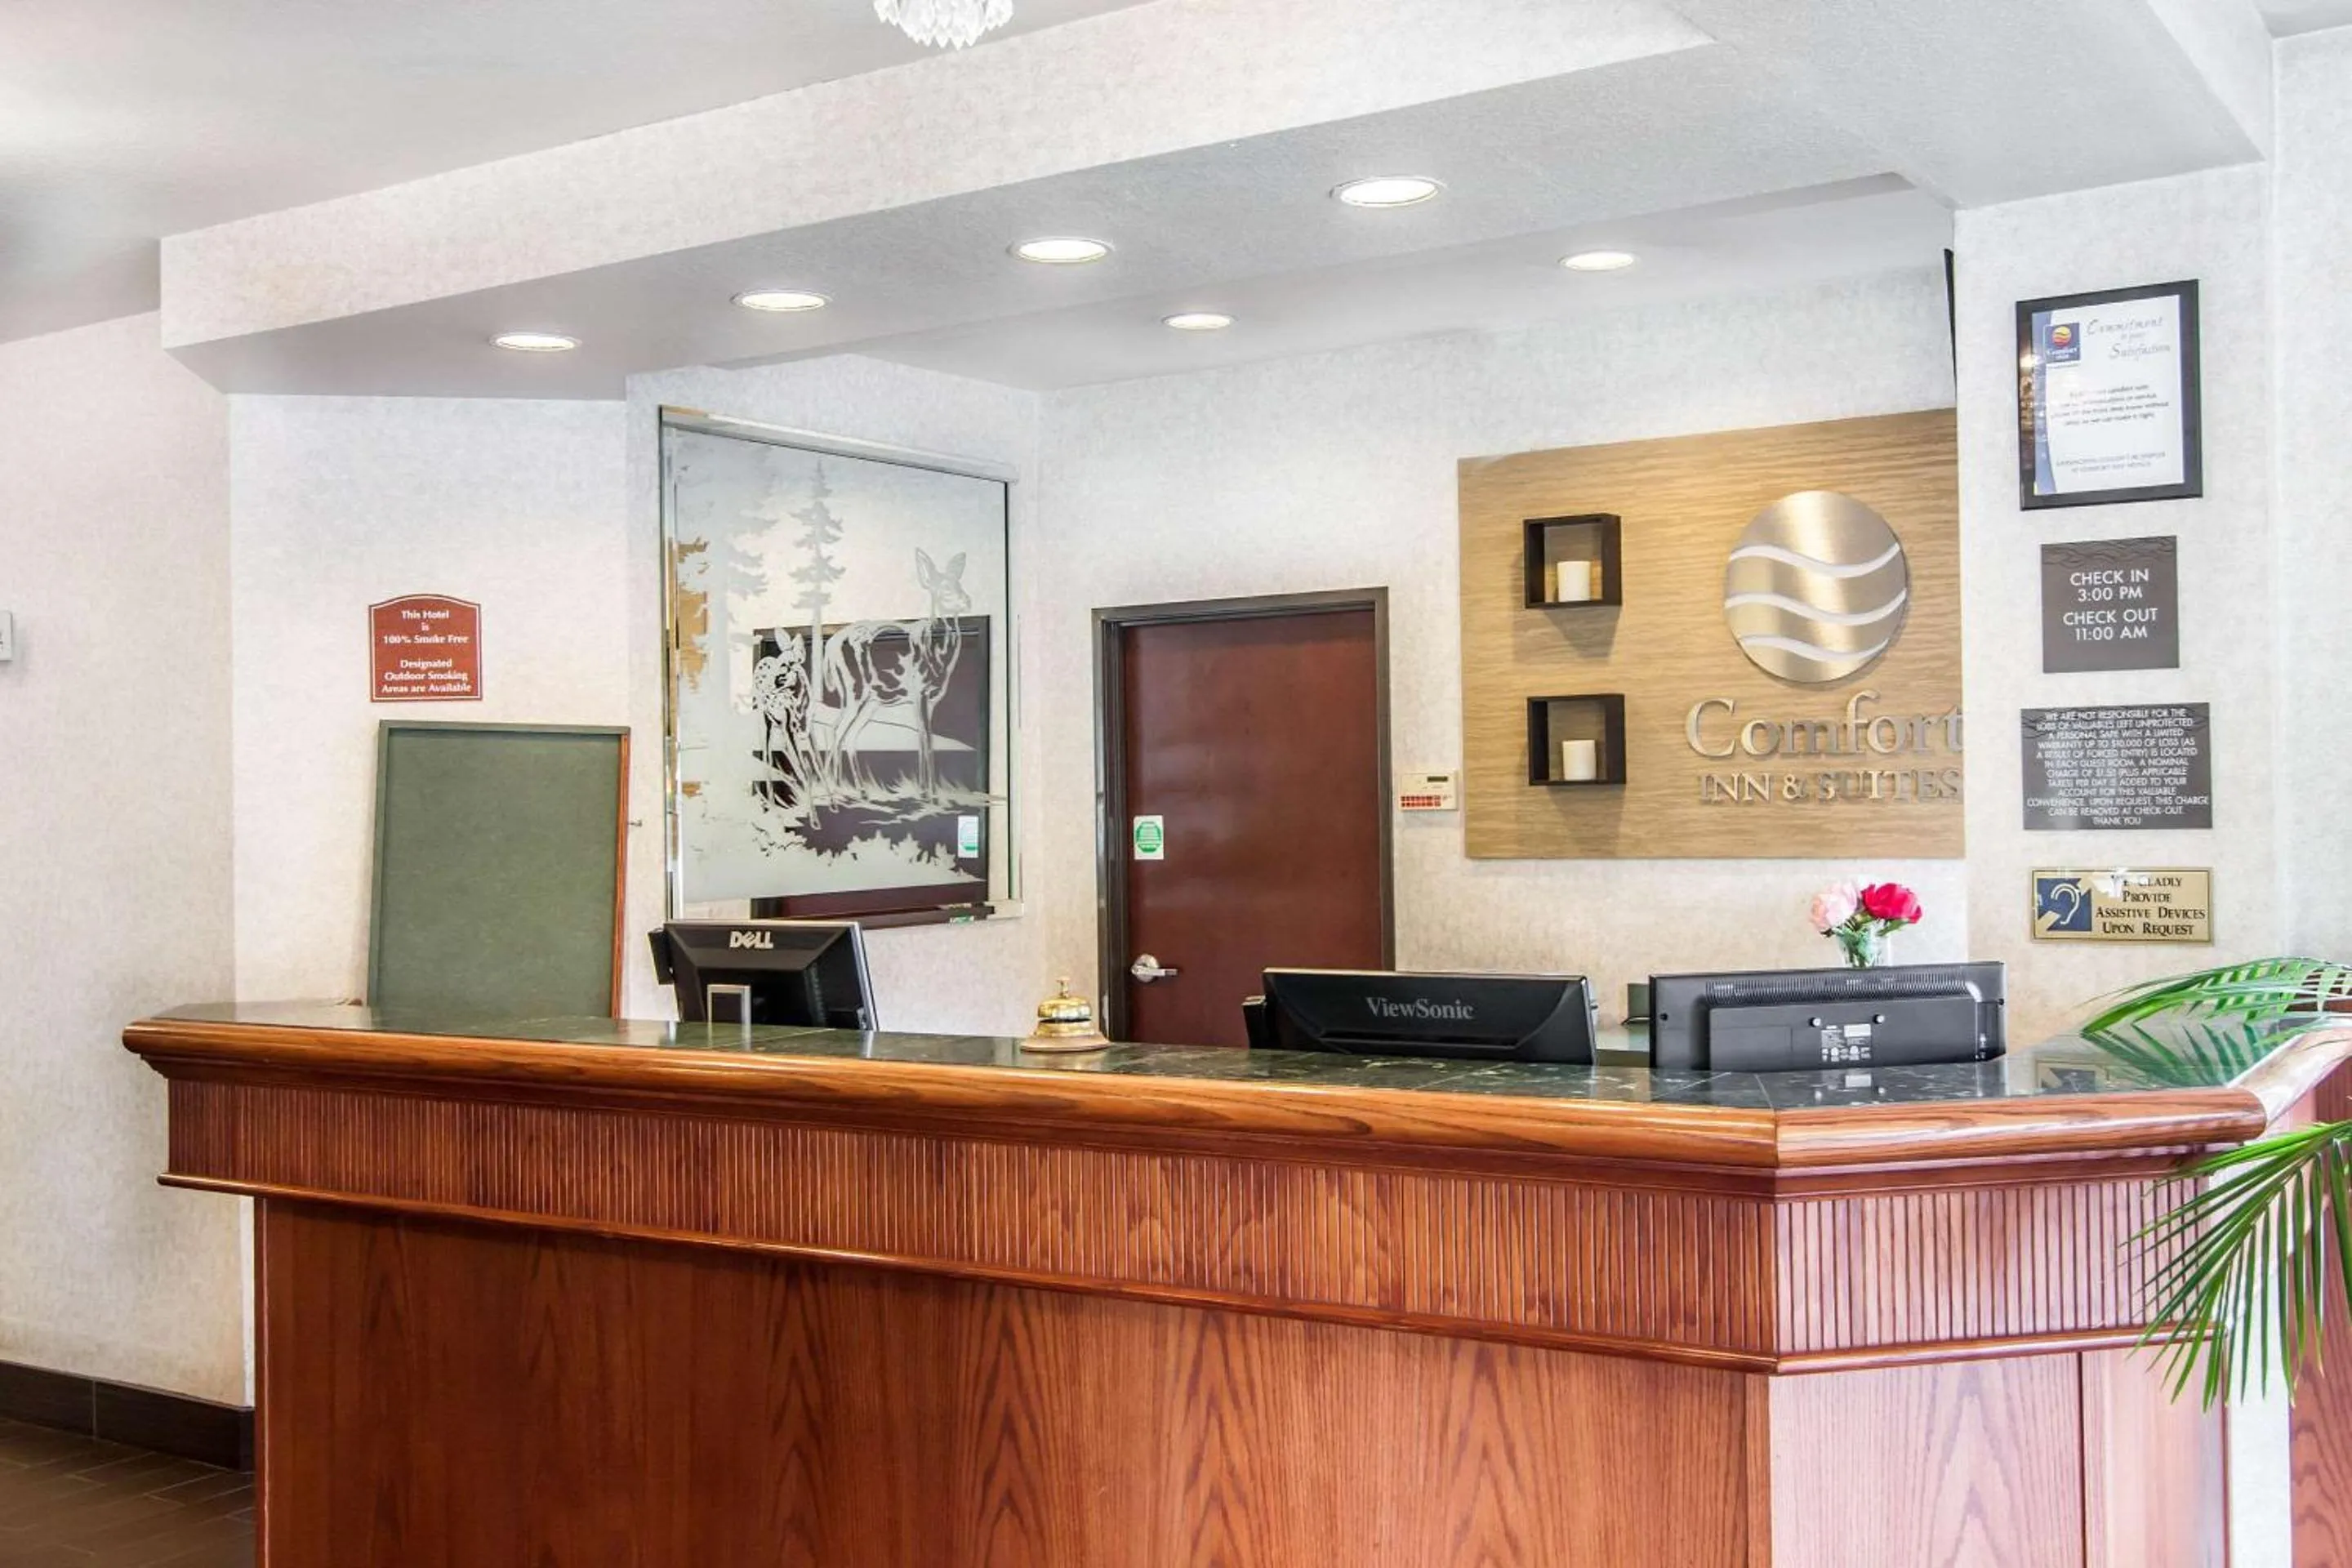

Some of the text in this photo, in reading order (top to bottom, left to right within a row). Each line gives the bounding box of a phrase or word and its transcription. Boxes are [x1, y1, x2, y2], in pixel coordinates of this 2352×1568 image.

[2069, 568, 2149, 586] CHECK IN
[2077, 586, 2143, 602] 3:00 PM
[401, 609, 450, 619] This Hotel
[2062, 608, 2158, 626] CHECK OUT
[421, 621, 430, 631] is
[2075, 626, 2148, 641] 11:00 AM
[384, 635, 470, 644] 100% Smoke Free
[399, 658, 452, 670] Designated
[384, 670, 469, 682] Outdoor Smoking
[381, 684, 408, 693] Areas
[428, 683, 471, 693] Available
[1686, 689, 1963, 758] Comfort
[2135, 718, 2194, 728] UNPROTECTED
[2154, 728, 2185, 737] LIMITED
[2158, 737, 2180, 746] LOSS
[2159, 746, 2198, 756] LOCATED
[2148, 756, 2189, 766] NOMINAL
[1699, 768, 1962, 803] INN & SUITES
[2119, 777, 2148, 786] ADDED
[2163, 776, 2187, 785] YOUR
[2137, 786, 2177, 795] VALUABLE
[2175, 795, 2209, 804] CHARGE
[2092, 816, 2141, 825] THANK YOU
[2123, 890, 2172, 902] PROVIDE
[2096, 906, 2206, 919] ASSISTIVE DEVICES
[2102, 922, 2195, 936] UPON REQUEST
[728, 930, 774, 949] DELL
[1365, 996, 1474, 1021] ViewSonic
